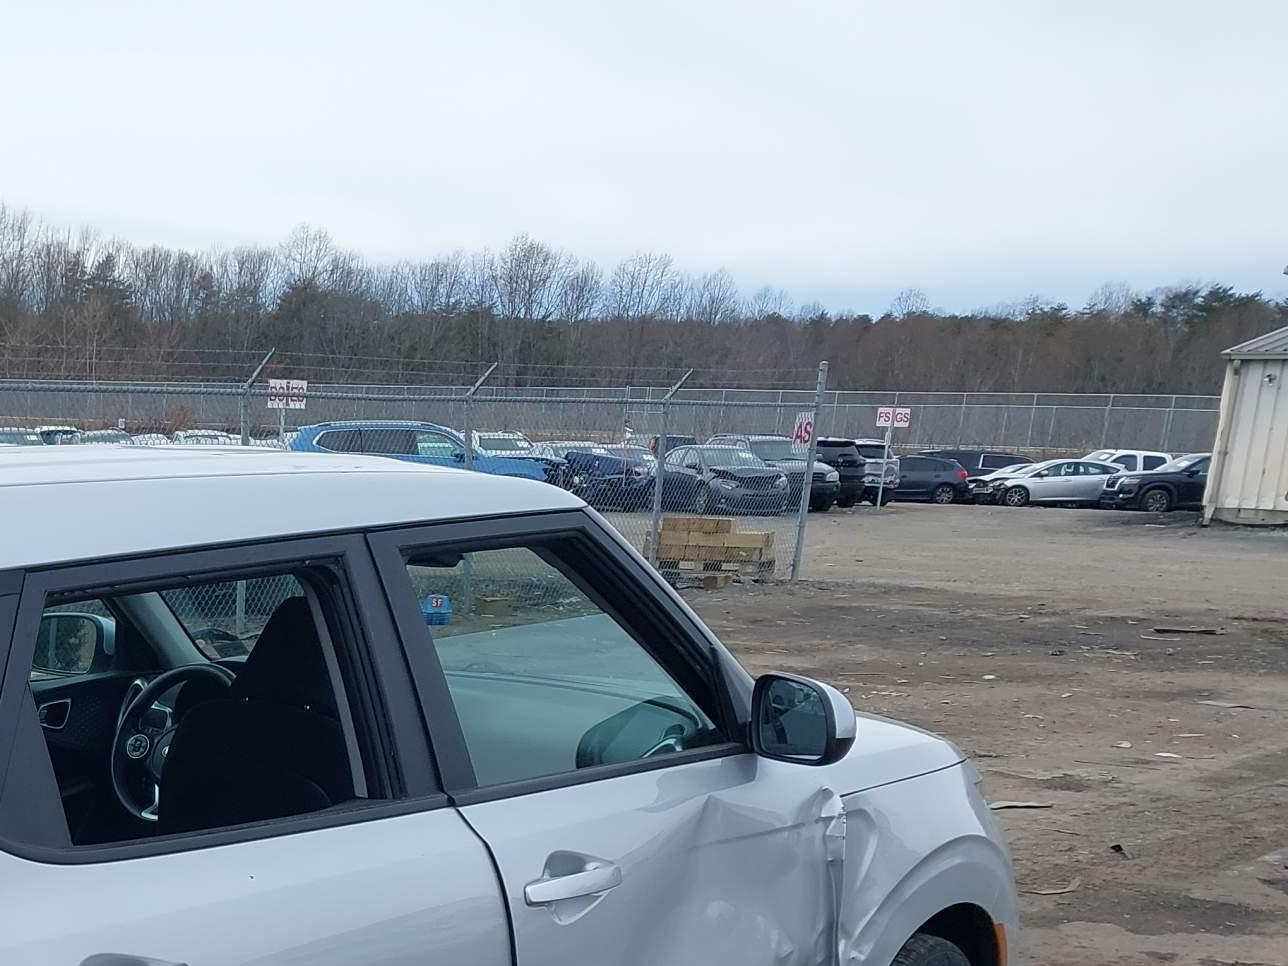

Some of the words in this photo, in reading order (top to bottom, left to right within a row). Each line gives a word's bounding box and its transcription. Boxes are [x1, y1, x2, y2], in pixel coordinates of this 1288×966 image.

[877, 411, 891, 423] FS
[895, 412, 910, 423] GS
[794, 421, 813, 444] AS
